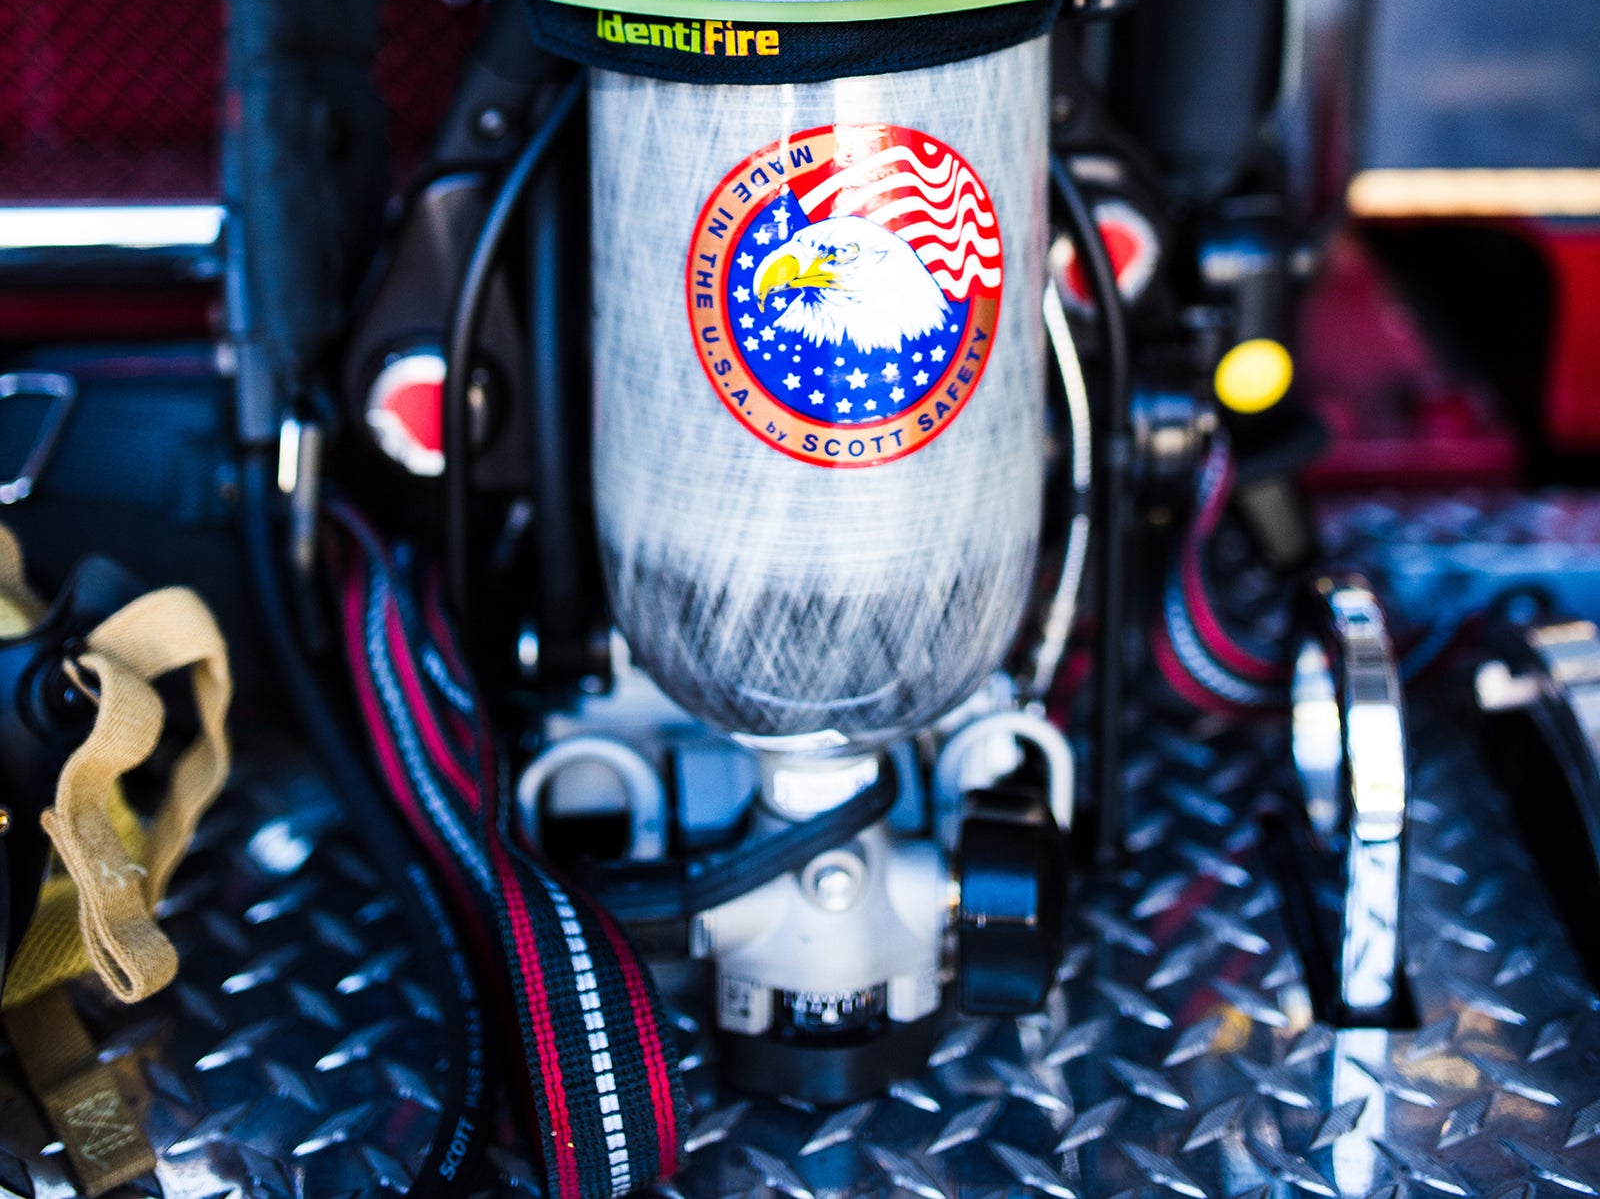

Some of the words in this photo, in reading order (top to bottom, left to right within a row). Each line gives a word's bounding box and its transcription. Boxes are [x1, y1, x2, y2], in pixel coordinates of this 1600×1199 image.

[732, 145, 813, 204] MADE
[708, 207, 734, 239] IN
[696, 253, 717, 309] THE
[701, 325, 753, 416] U.S.A.
[918, 328, 988, 432] SAFETY
[765, 421, 787, 442] by
[801, 429, 904, 457] SCOTT
[439, 1115, 475, 1182] SCOTT
